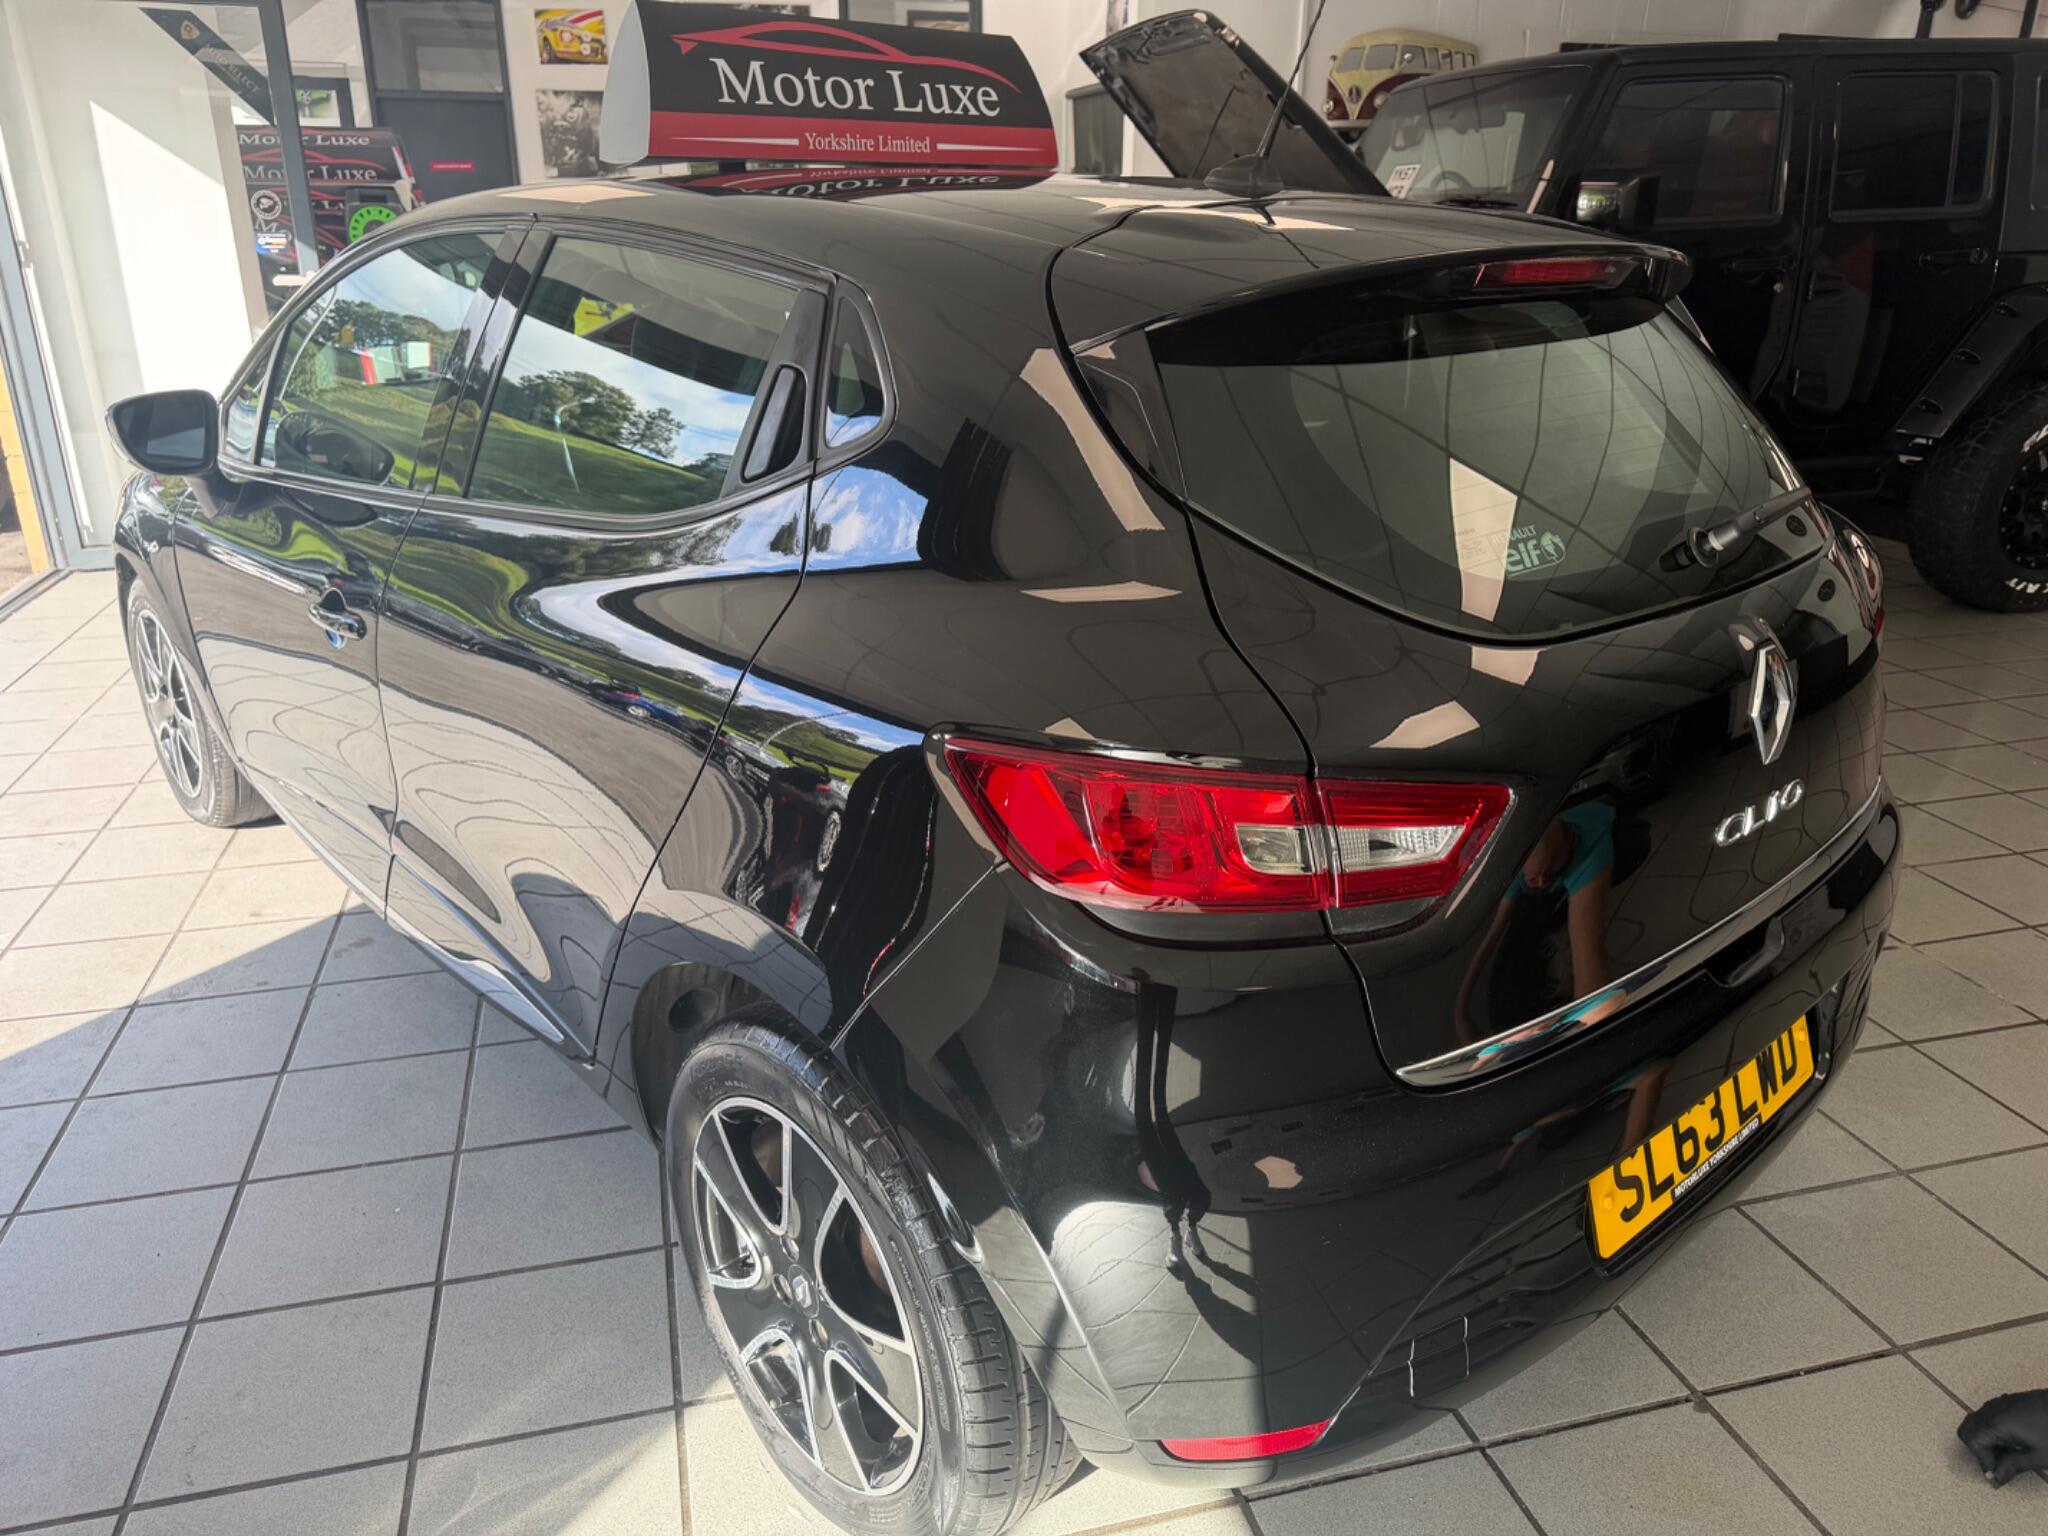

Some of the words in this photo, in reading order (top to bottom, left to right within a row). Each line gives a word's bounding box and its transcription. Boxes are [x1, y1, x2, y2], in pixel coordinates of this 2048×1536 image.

[709, 57, 874, 111] Motor
[886, 69, 1001, 117] Luxe
[316, 134, 370, 146] Luxe
[805, 132, 875, 152] Yorkshire
[878, 135, 931, 153] Limited
[320, 165, 377, 181] Luxe
[1505, 538, 1541, 573] elf
[1714, 779, 1804, 847] CLIO
[1612, 1088, 1726, 1223] SL63
